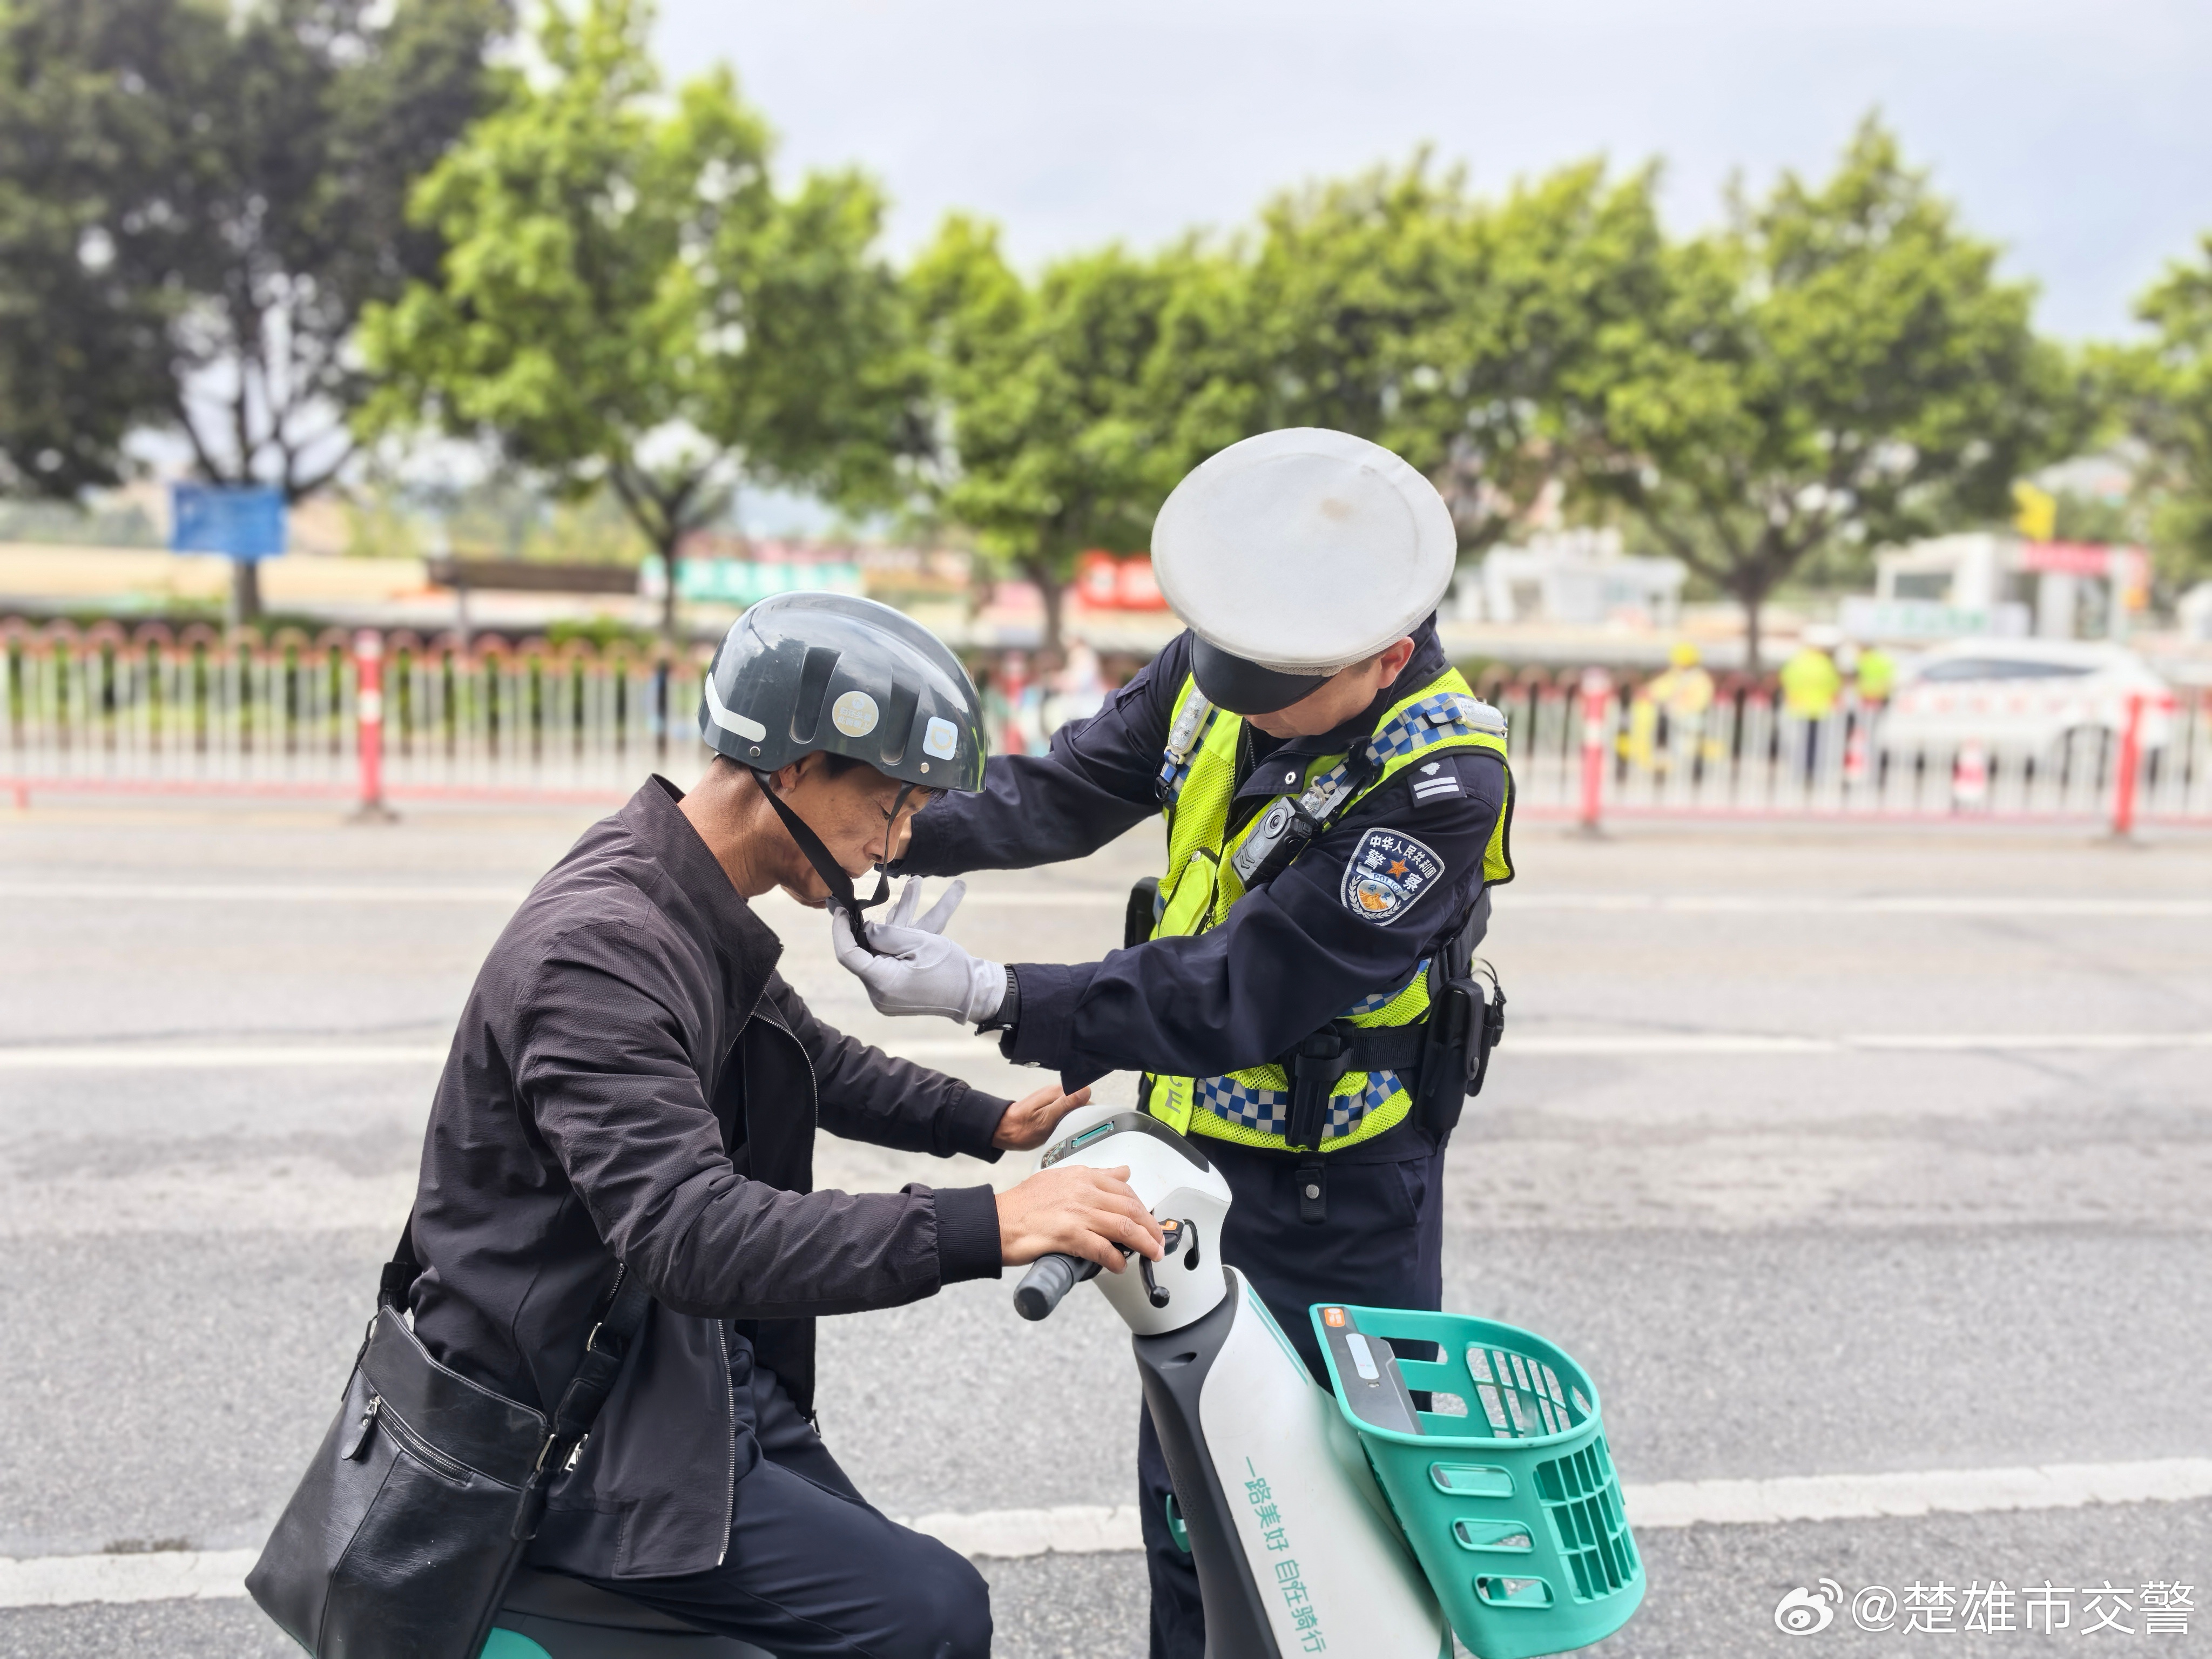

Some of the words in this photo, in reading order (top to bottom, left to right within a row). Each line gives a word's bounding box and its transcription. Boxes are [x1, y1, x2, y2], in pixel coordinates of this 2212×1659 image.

[1370, 835, 1437, 879] 中华人民共和国
[1373, 873, 1402, 893] POLICE
[1244, 1456, 1290, 1552] 一路美好
[1274, 1559, 1327, 1653] 自在骑行
